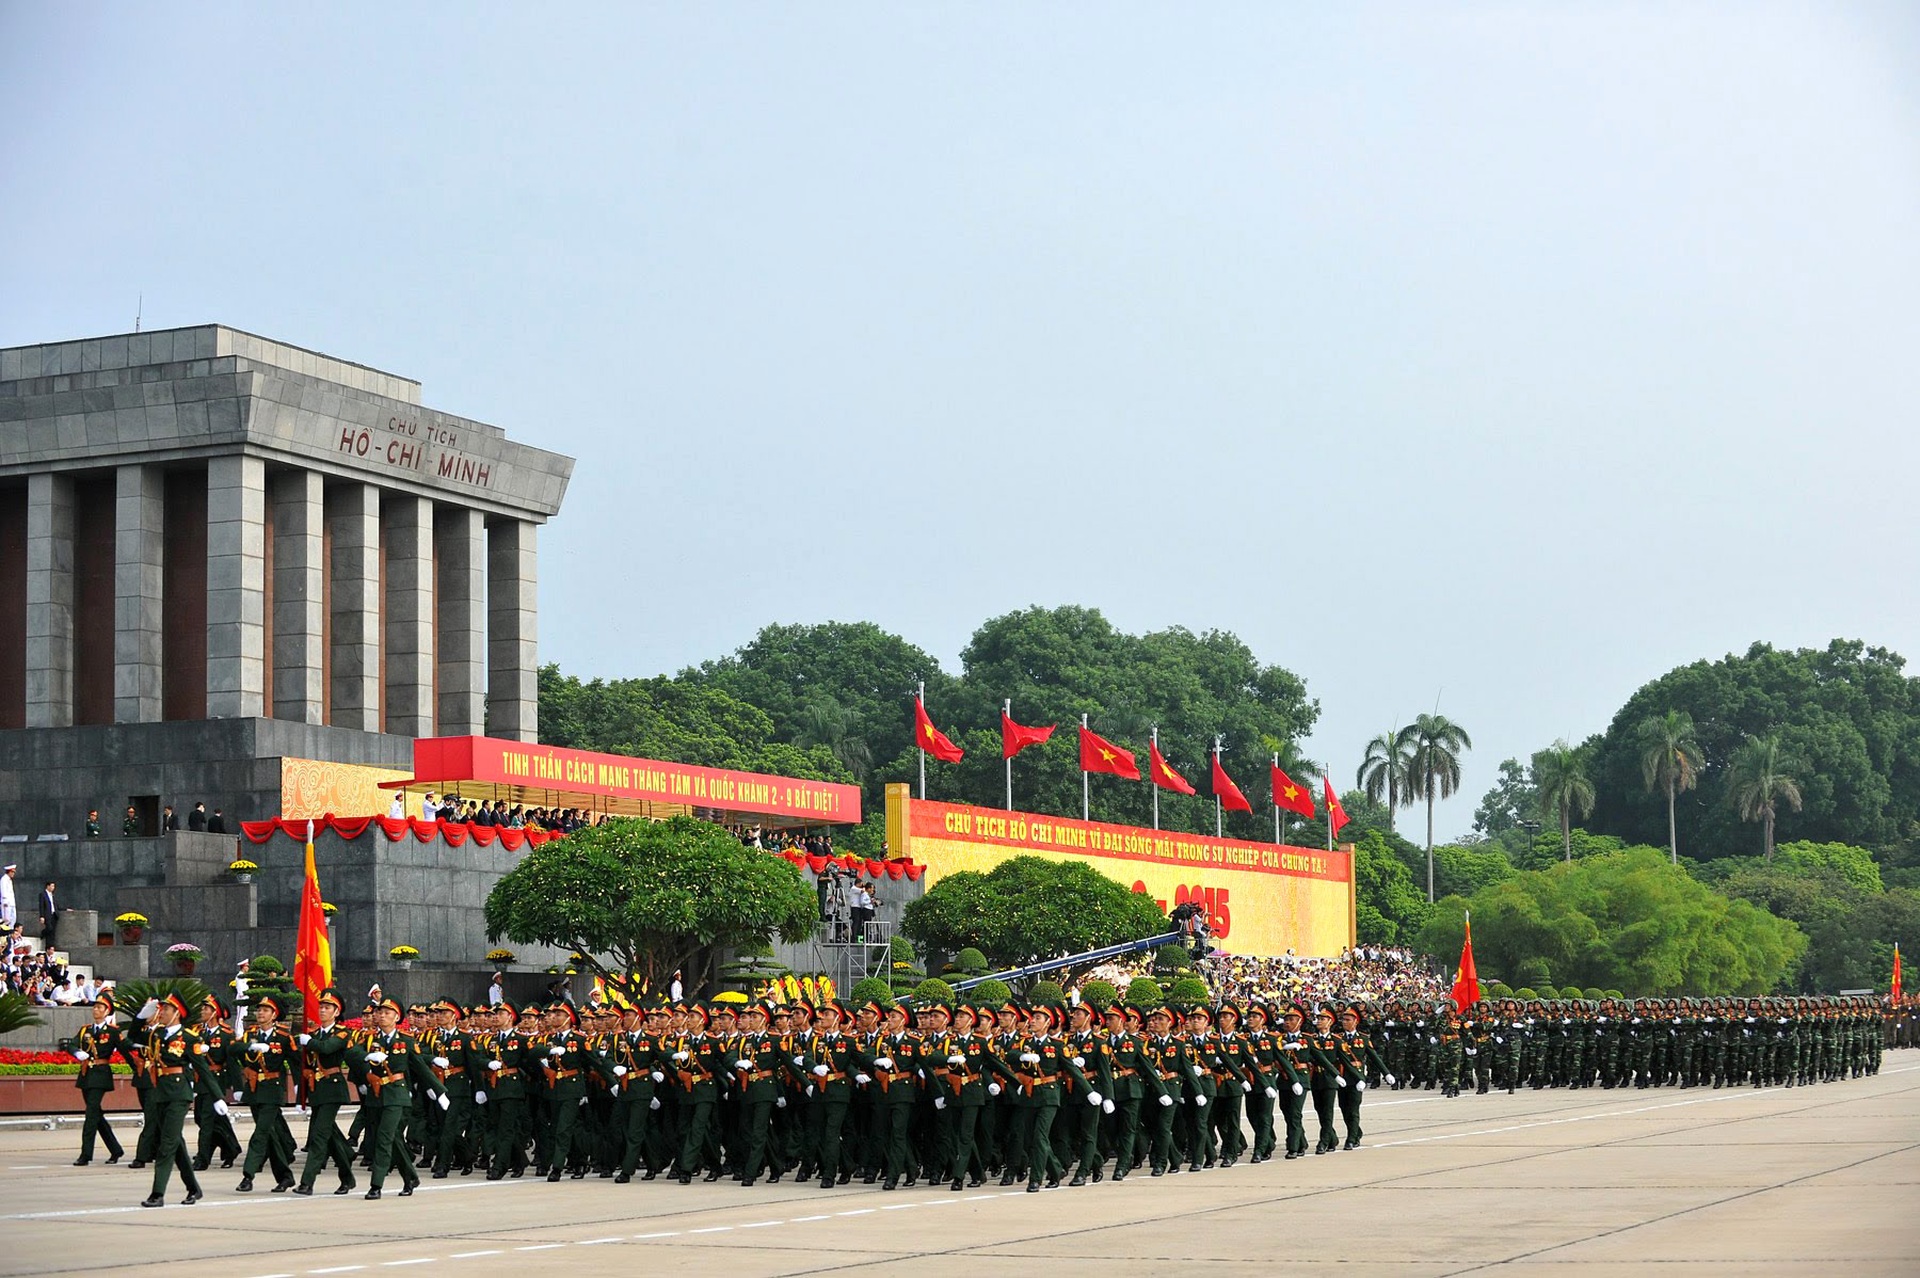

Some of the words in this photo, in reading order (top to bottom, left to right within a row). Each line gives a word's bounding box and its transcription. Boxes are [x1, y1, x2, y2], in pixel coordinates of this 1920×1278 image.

[437, 451, 491, 487] MINH
[502, 751, 530, 777] TINH
[532, 751, 563, 780] THẦN
[566, 757, 595, 785] CÁCH
[598, 764, 630, 792] MẠNG
[633, 767, 667, 794] THÁNG
[670, 770, 691, 797] TÁM
[694, 773, 707, 798] VÀ
[709, 774, 735, 801] QUỐC
[737, 779, 769, 805] KHÁNH
[794, 784, 811, 809] BẤT
[813, 789, 833, 815] DIỆT
[945, 810, 971, 834] CHỦ
[975, 816, 1006, 841] TỊCH
[1009, 814, 1027, 841] HỒ
[1030, 821, 1053, 844] CHÍ
[1055, 826, 1087, 848] MINH
[1103, 832, 1123, 855] ĐẠI
[1124, 829, 1153, 855] SỐNG
[1176, 841, 1210, 862] TRONG
[1225, 845, 1260, 869] NGHIỆP
[1281, 851, 1310, 873] CHÚNG
